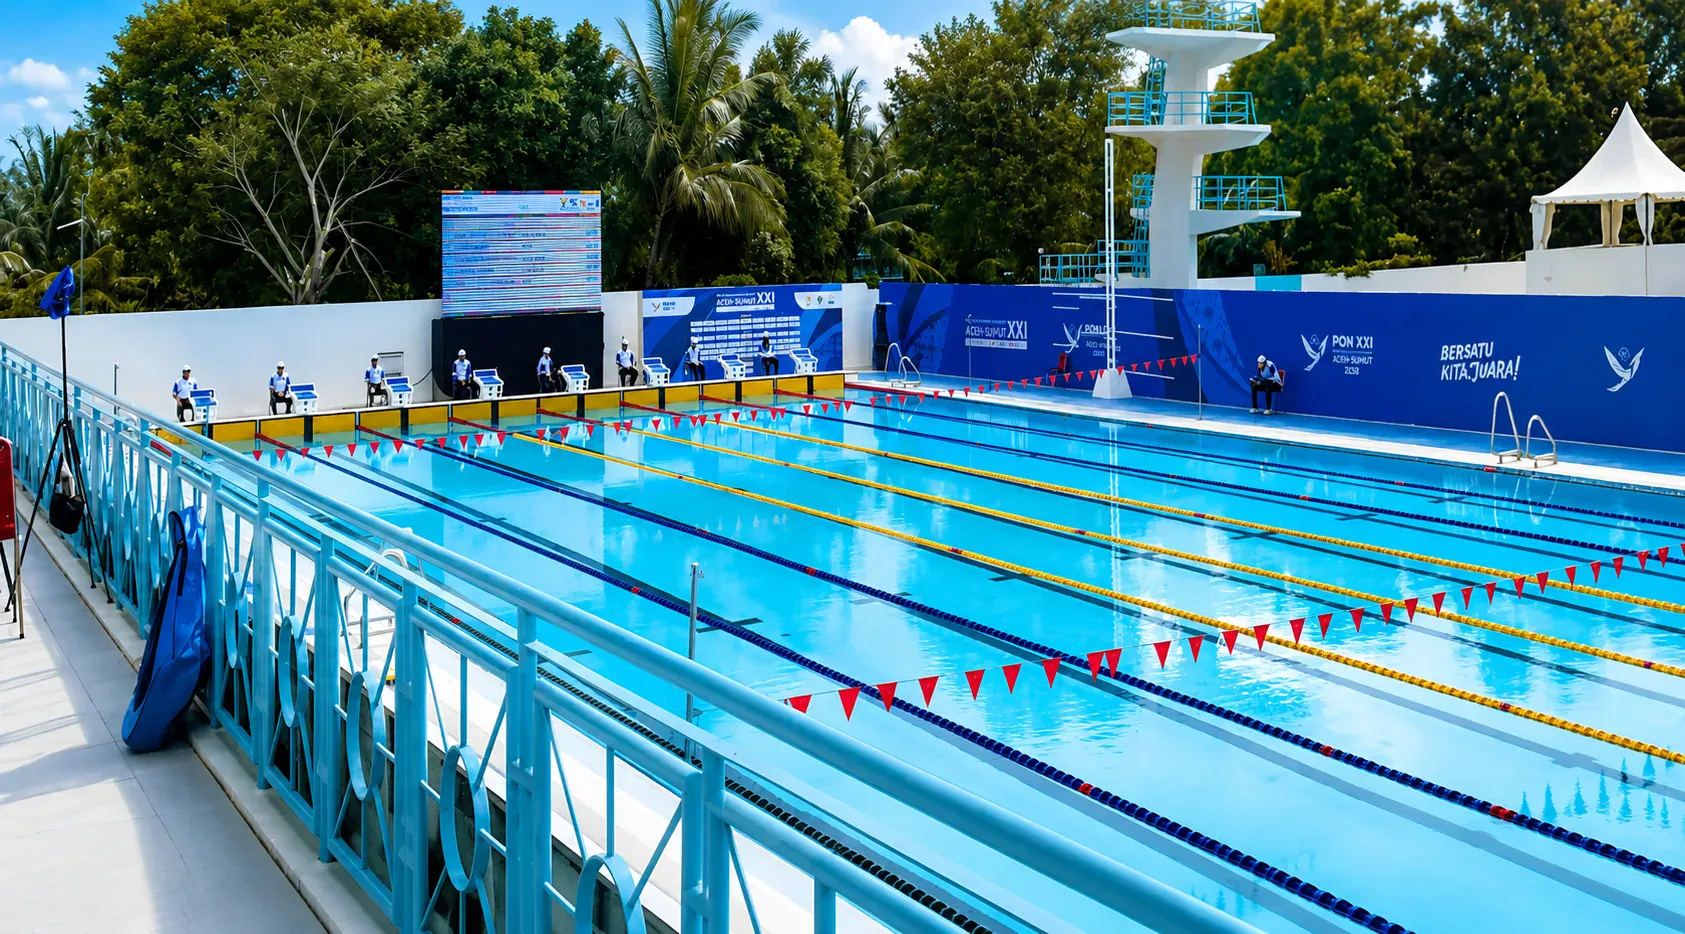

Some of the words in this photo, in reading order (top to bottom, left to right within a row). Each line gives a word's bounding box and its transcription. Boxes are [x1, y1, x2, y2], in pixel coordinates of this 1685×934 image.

[756, 291, 775, 304] XXI
[1007, 320, 1028, 339] XXI
[1332, 335, 1354, 348] PON
[1356, 336, 1373, 349] XXI
[1440, 341, 1494, 361] BERSATU
